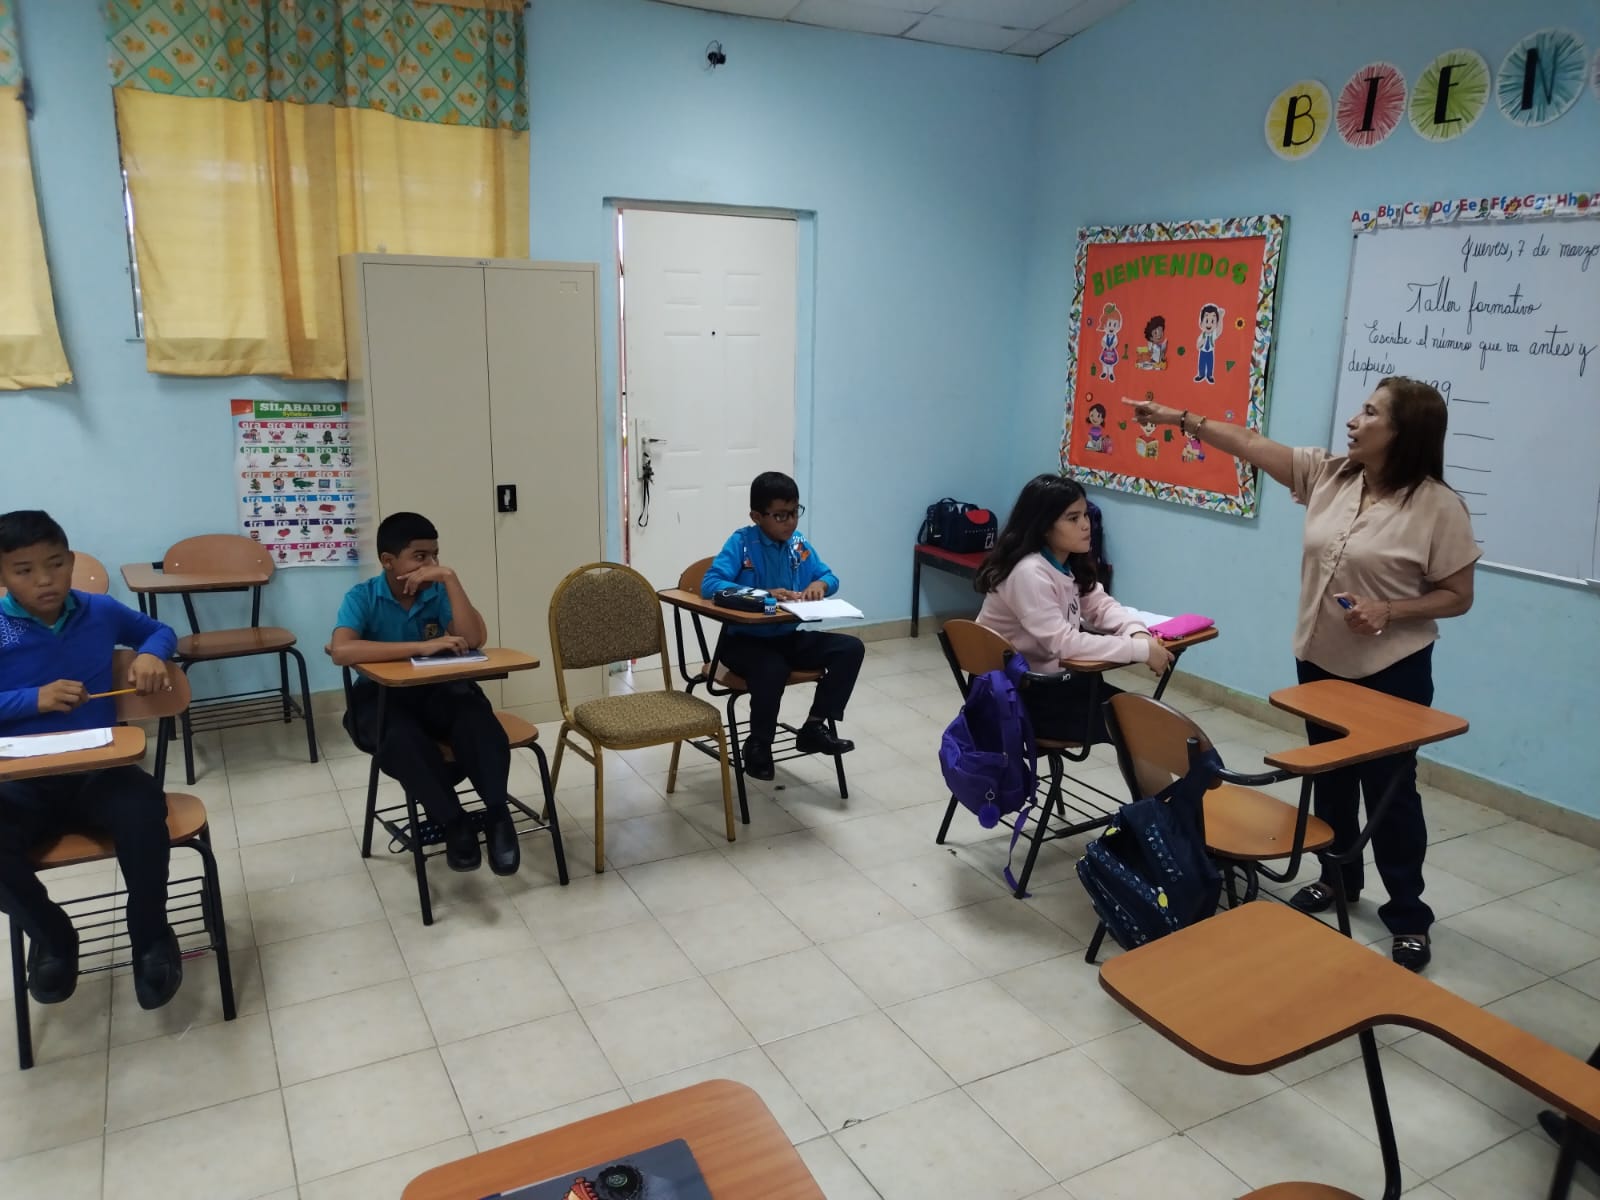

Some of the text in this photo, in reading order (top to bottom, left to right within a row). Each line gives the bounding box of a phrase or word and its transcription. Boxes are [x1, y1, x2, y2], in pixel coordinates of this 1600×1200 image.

[1351, 210, 1370, 223] Aa
[1377, 205, 1395, 218] Bb
[1404, 202, 1421, 214] Cc
[1431, 200, 1452, 213] Dd
[1460, 198, 1478, 211] Ee
[1491, 195, 1507, 210] Ff
[1556, 191, 1577, 207] Hh
[1518, 239, 1526, 257] 7
[1532, 233, 1551, 257] de
[1558, 241, 1600, 272] marzo
[1091, 252, 1249, 297] BIENVENIDOS
[1405, 275, 1543, 335] Taller formativo
[1347, 348, 1396, 388] después
[1363, 319, 1599, 378] Escribe el número que va antes y
[260, 402, 337, 413] SILABARIO
[272, 543, 291, 551] cre
